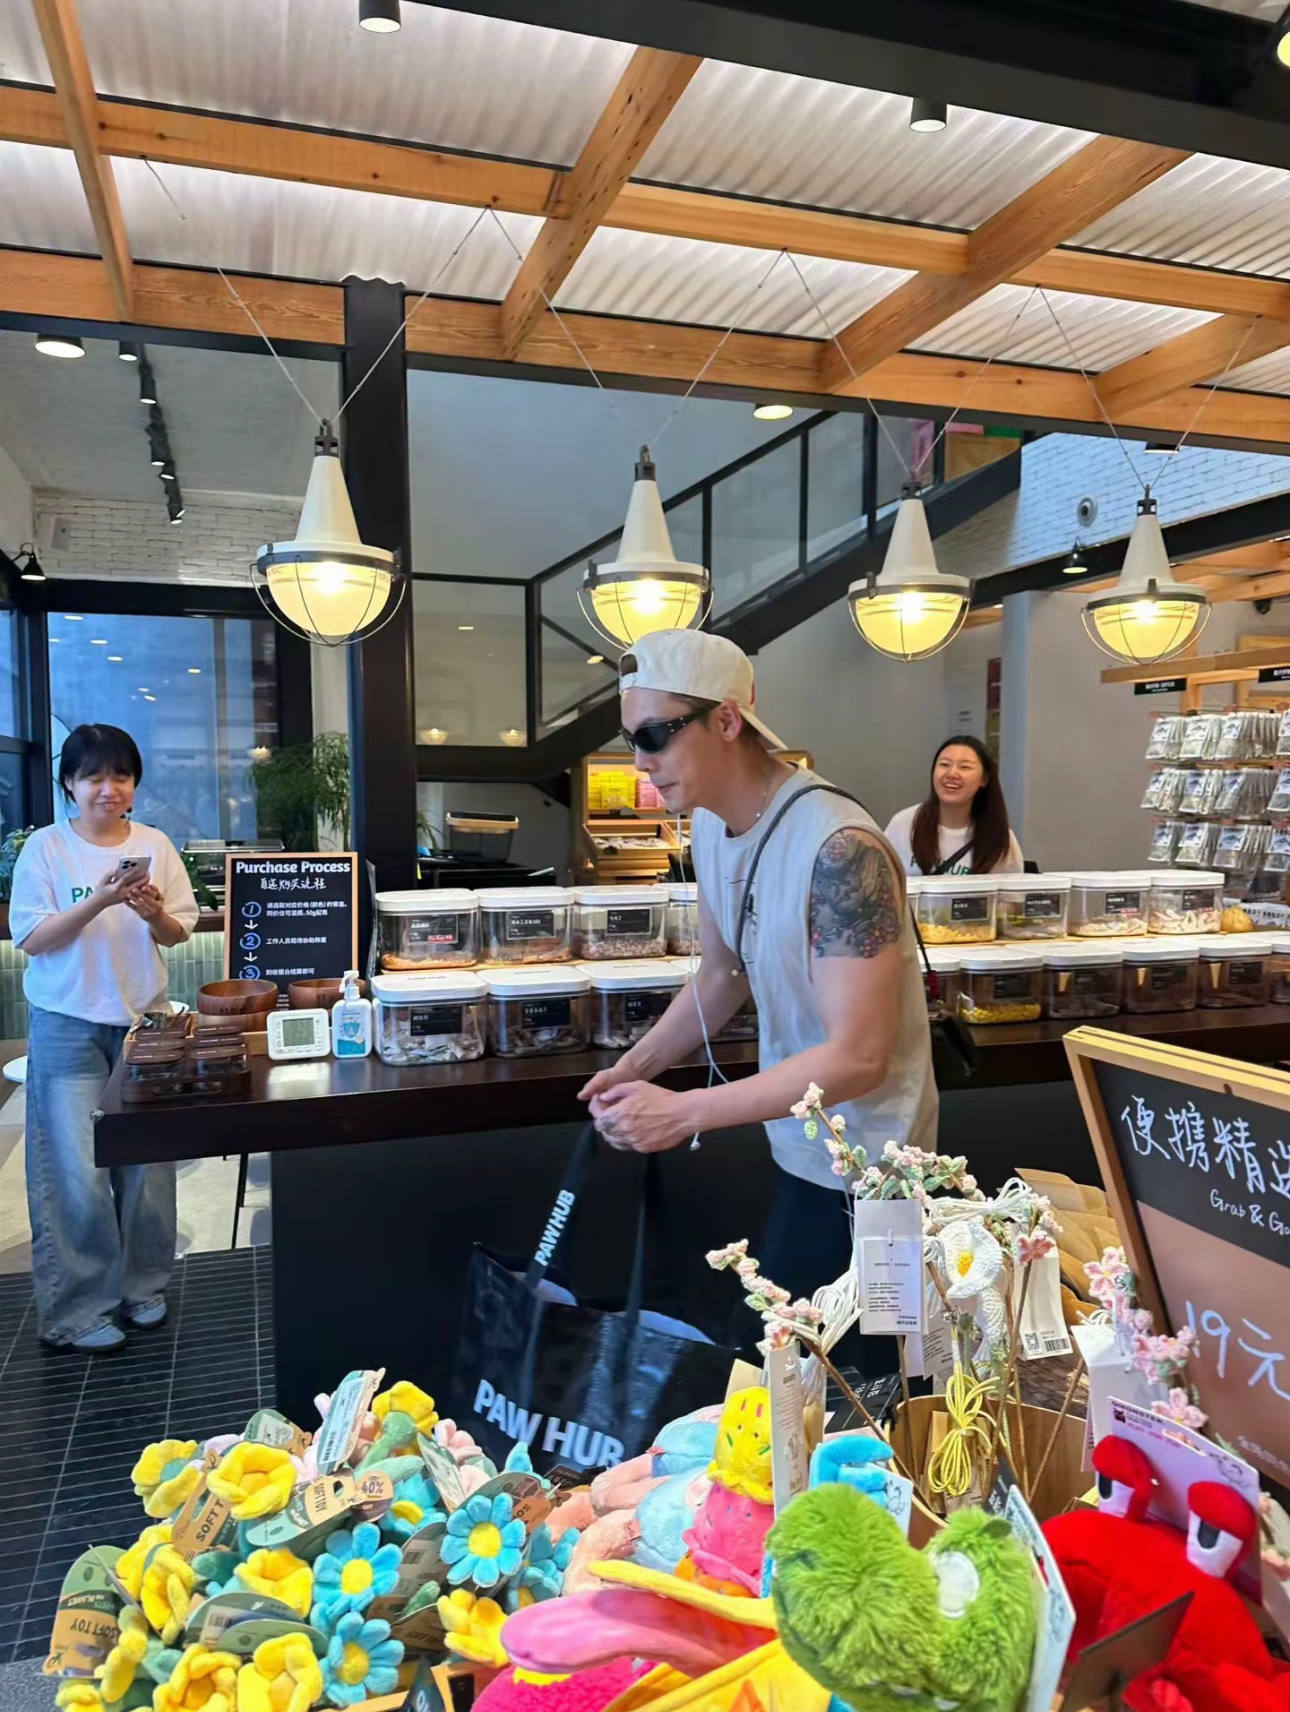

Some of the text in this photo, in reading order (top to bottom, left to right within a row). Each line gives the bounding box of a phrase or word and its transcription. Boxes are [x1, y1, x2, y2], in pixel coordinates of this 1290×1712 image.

[236, 861, 351, 874] Purchase Process
[1210, 1188, 1246, 1217] Grab
[1249, 1204, 1265, 1227] &
[534, 1189, 575, 1266] PAWHUB
[473, 1378, 543, 1446] PAW
[362, 1481, 384, 1495] 40%
[196, 1508, 219, 1542] SOFT
[70, 1618, 92, 1634] TOY
